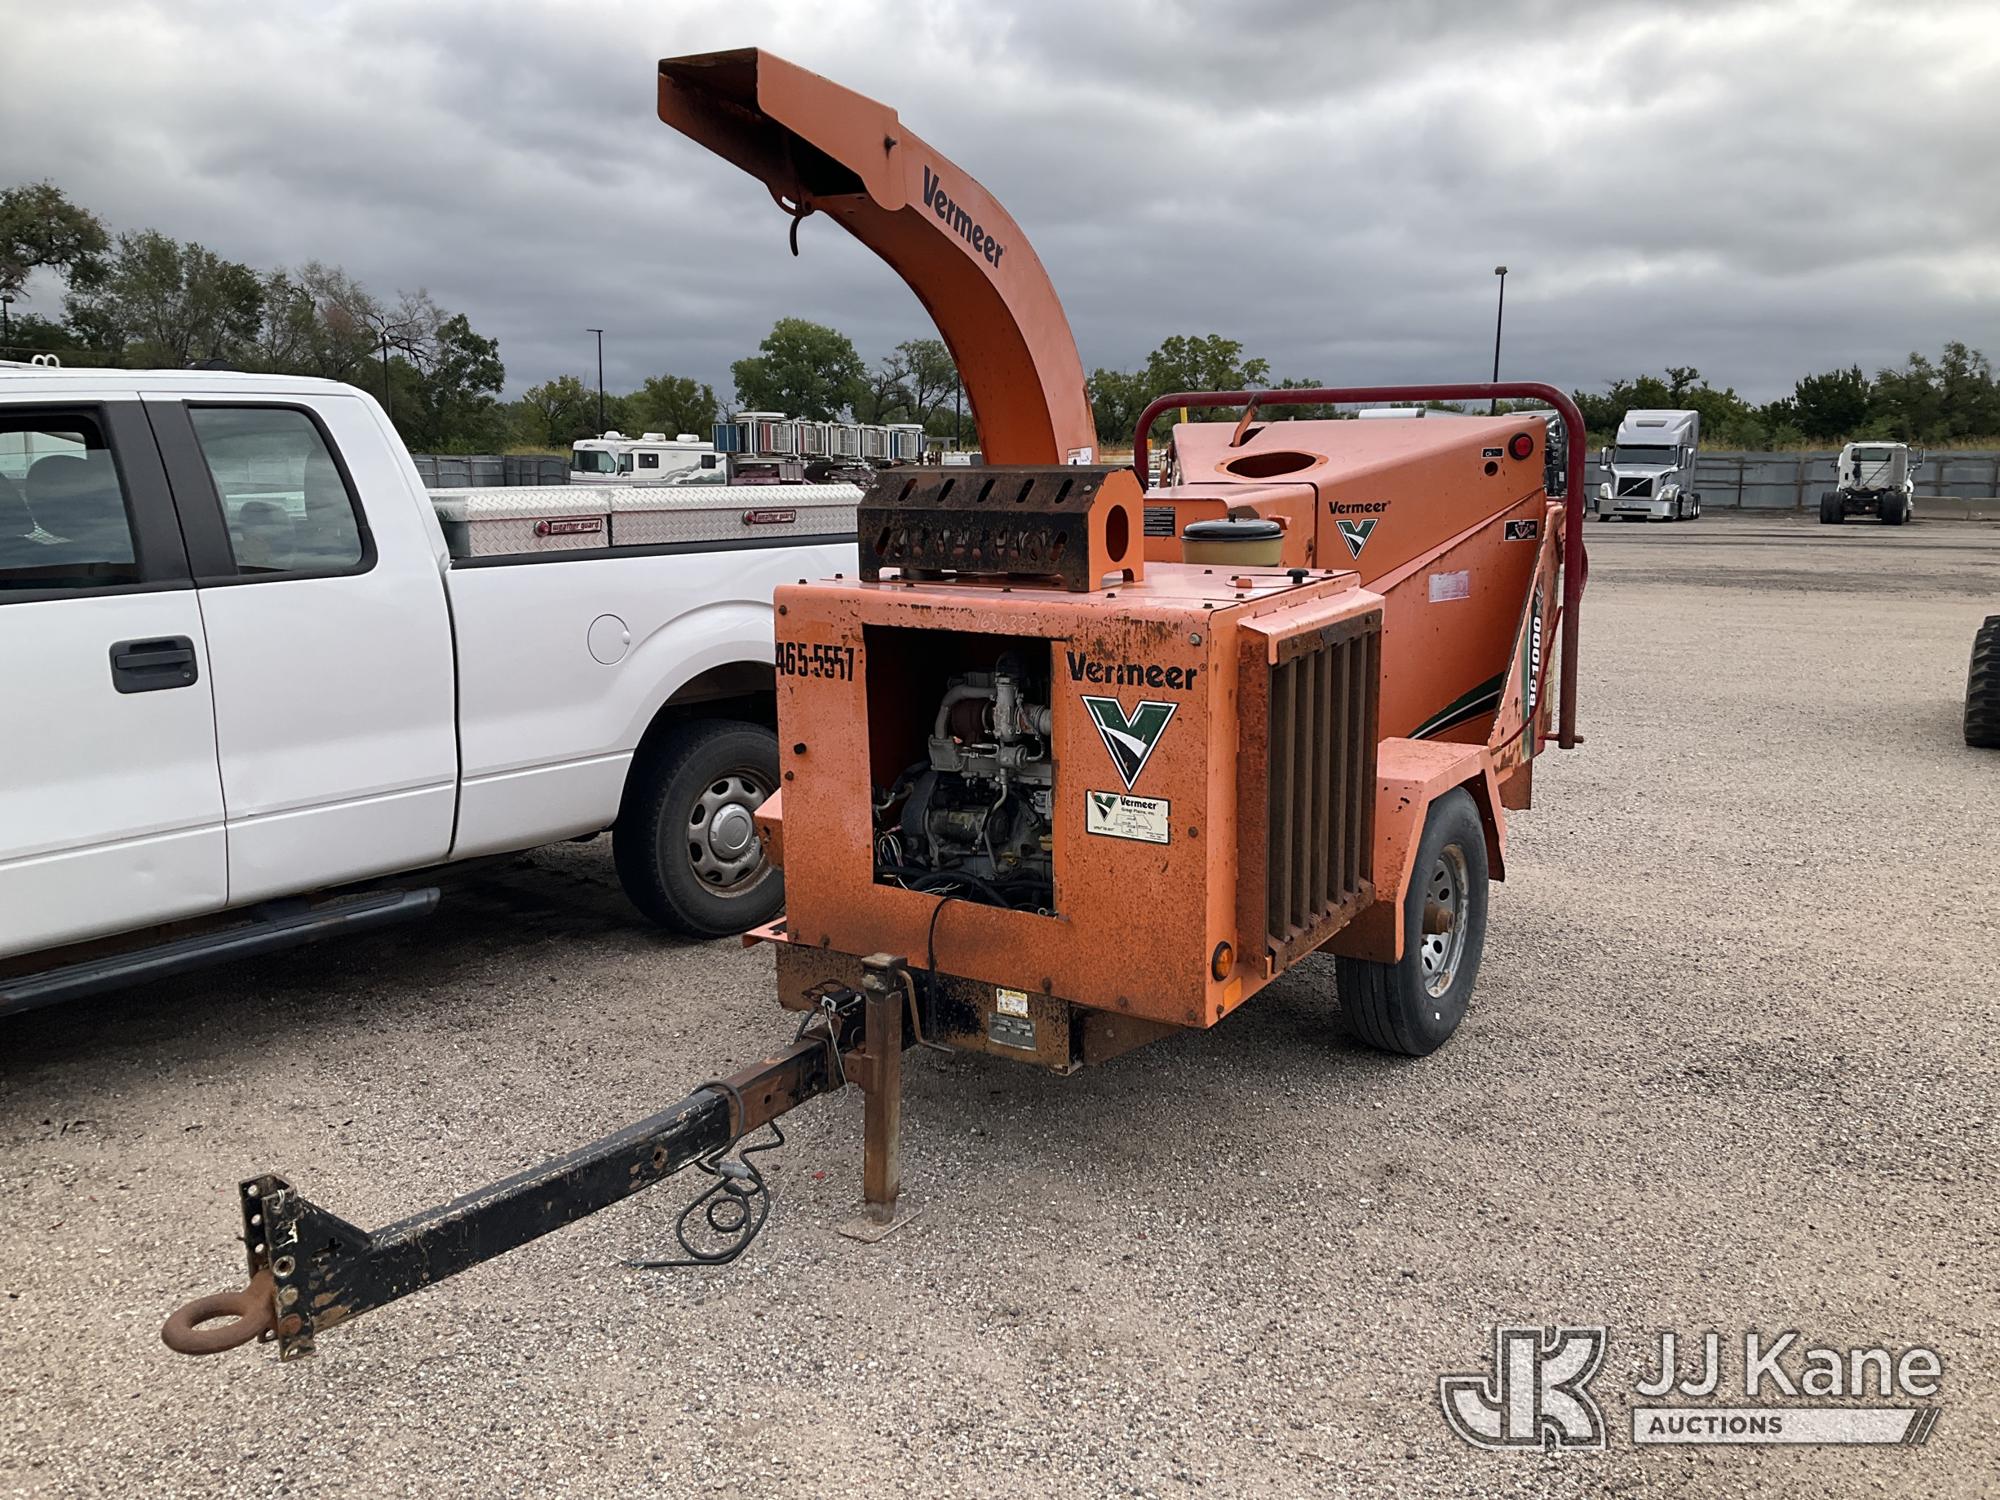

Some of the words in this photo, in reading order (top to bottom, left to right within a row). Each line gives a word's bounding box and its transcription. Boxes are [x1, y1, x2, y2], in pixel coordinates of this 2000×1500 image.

[923, 164, 1003, 269] Vermeer
[1328, 501, 1388, 515] Vermeer
[1531, 617, 1542, 677] 1000
[1066, 650, 1198, 691] Vermeer
[1529, 679, 1538, 706] BC
[1120, 796, 1157, 810] Vermeer
